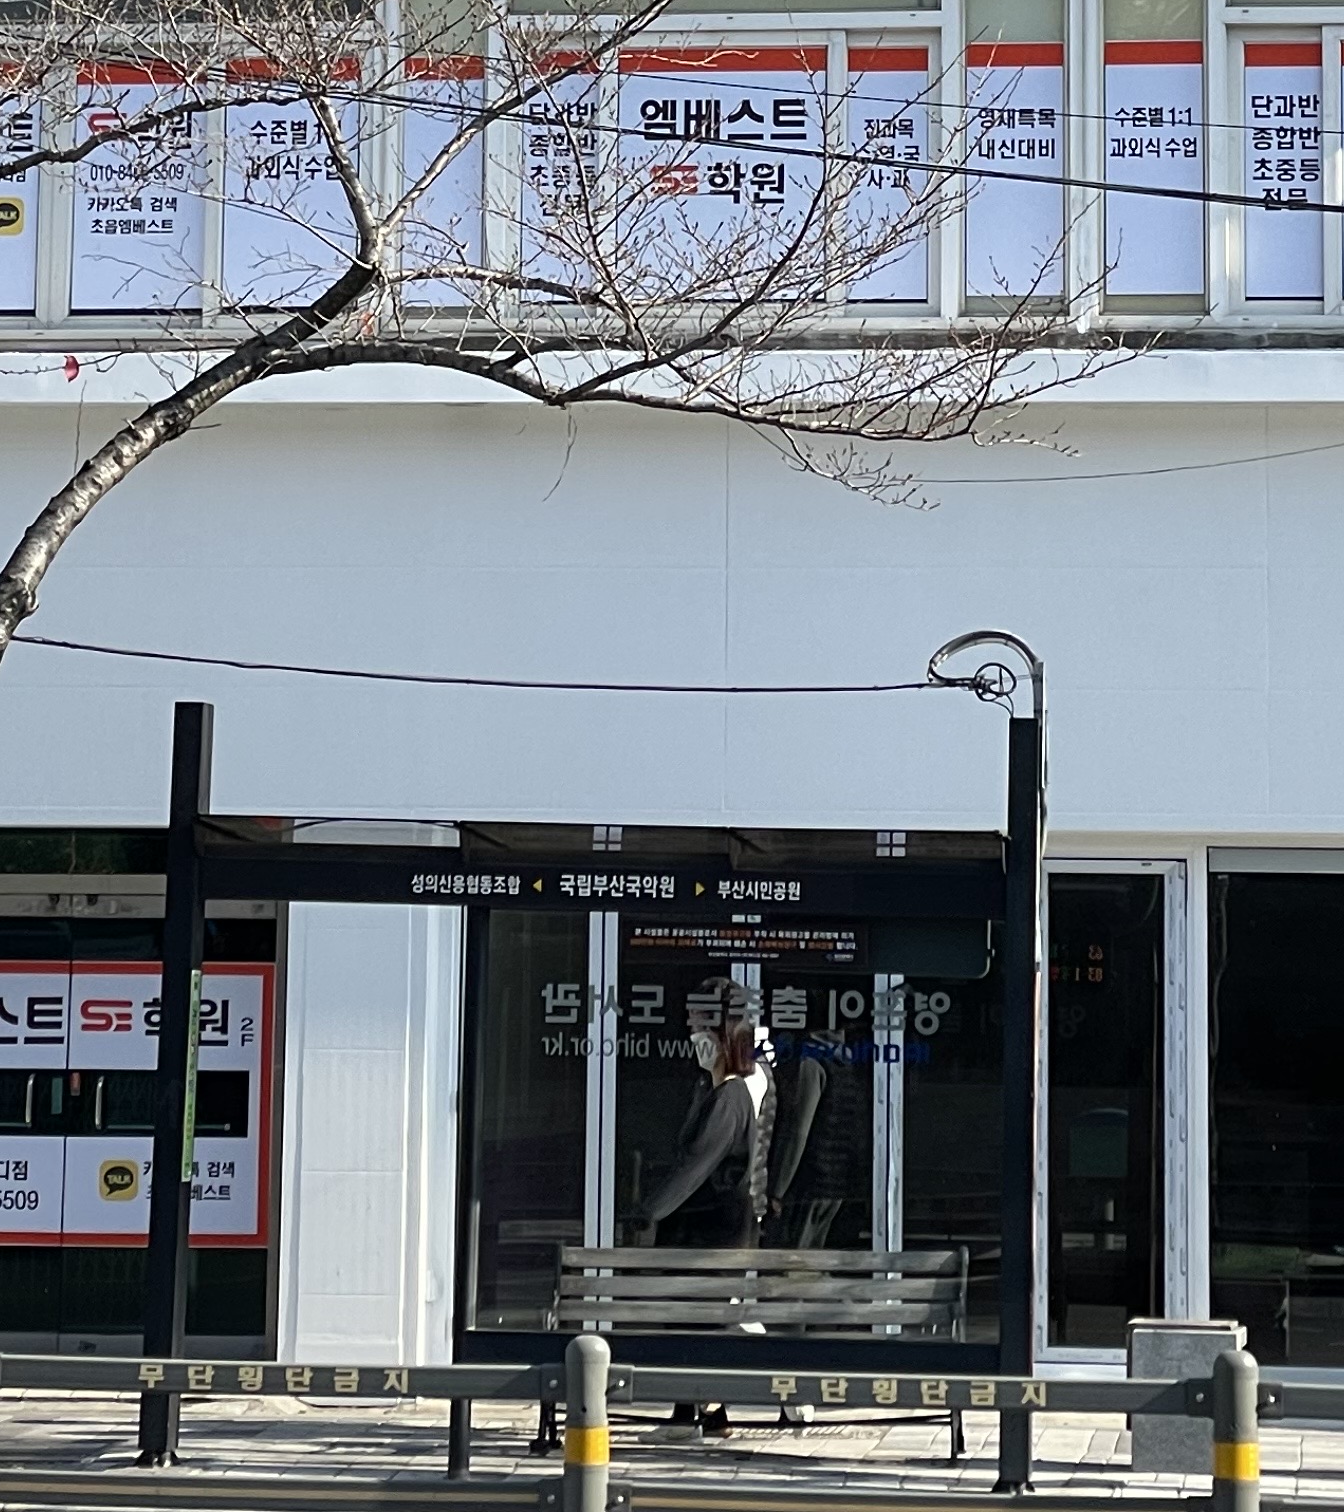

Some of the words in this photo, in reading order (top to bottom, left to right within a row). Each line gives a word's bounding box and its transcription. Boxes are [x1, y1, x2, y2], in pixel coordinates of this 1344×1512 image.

[978, 108, 1056, 129] 영재특목
[1114, 106, 1163, 129] 수준별
[1250, 94, 1320, 119] 단과반
[249, 119, 308, 145] 수준별
[640, 98, 808, 141] 엠베스트
[978, 137, 1056, 160] 내신대비
[1110, 137, 1161, 159] 과외식
[1165, 136, 1198, 159] 수업
[1252, 126, 1320, 152] 종합반
[1252, 157, 1321, 182] 초중등
[706, 162, 786, 205] 학원
[149, 196, 178, 213] 검색
[411, 874, 521, 895] 성의신용협동조합
[559, 874, 676, 899] 국립부산국악원
[717, 880, 801, 901] 부산시민공원
[206, 1161, 236, 1179] 검색
[138, 1361, 413, 1396] 무단횡단금지
[769, 1374, 1049, 1410] 무단횡단금지
